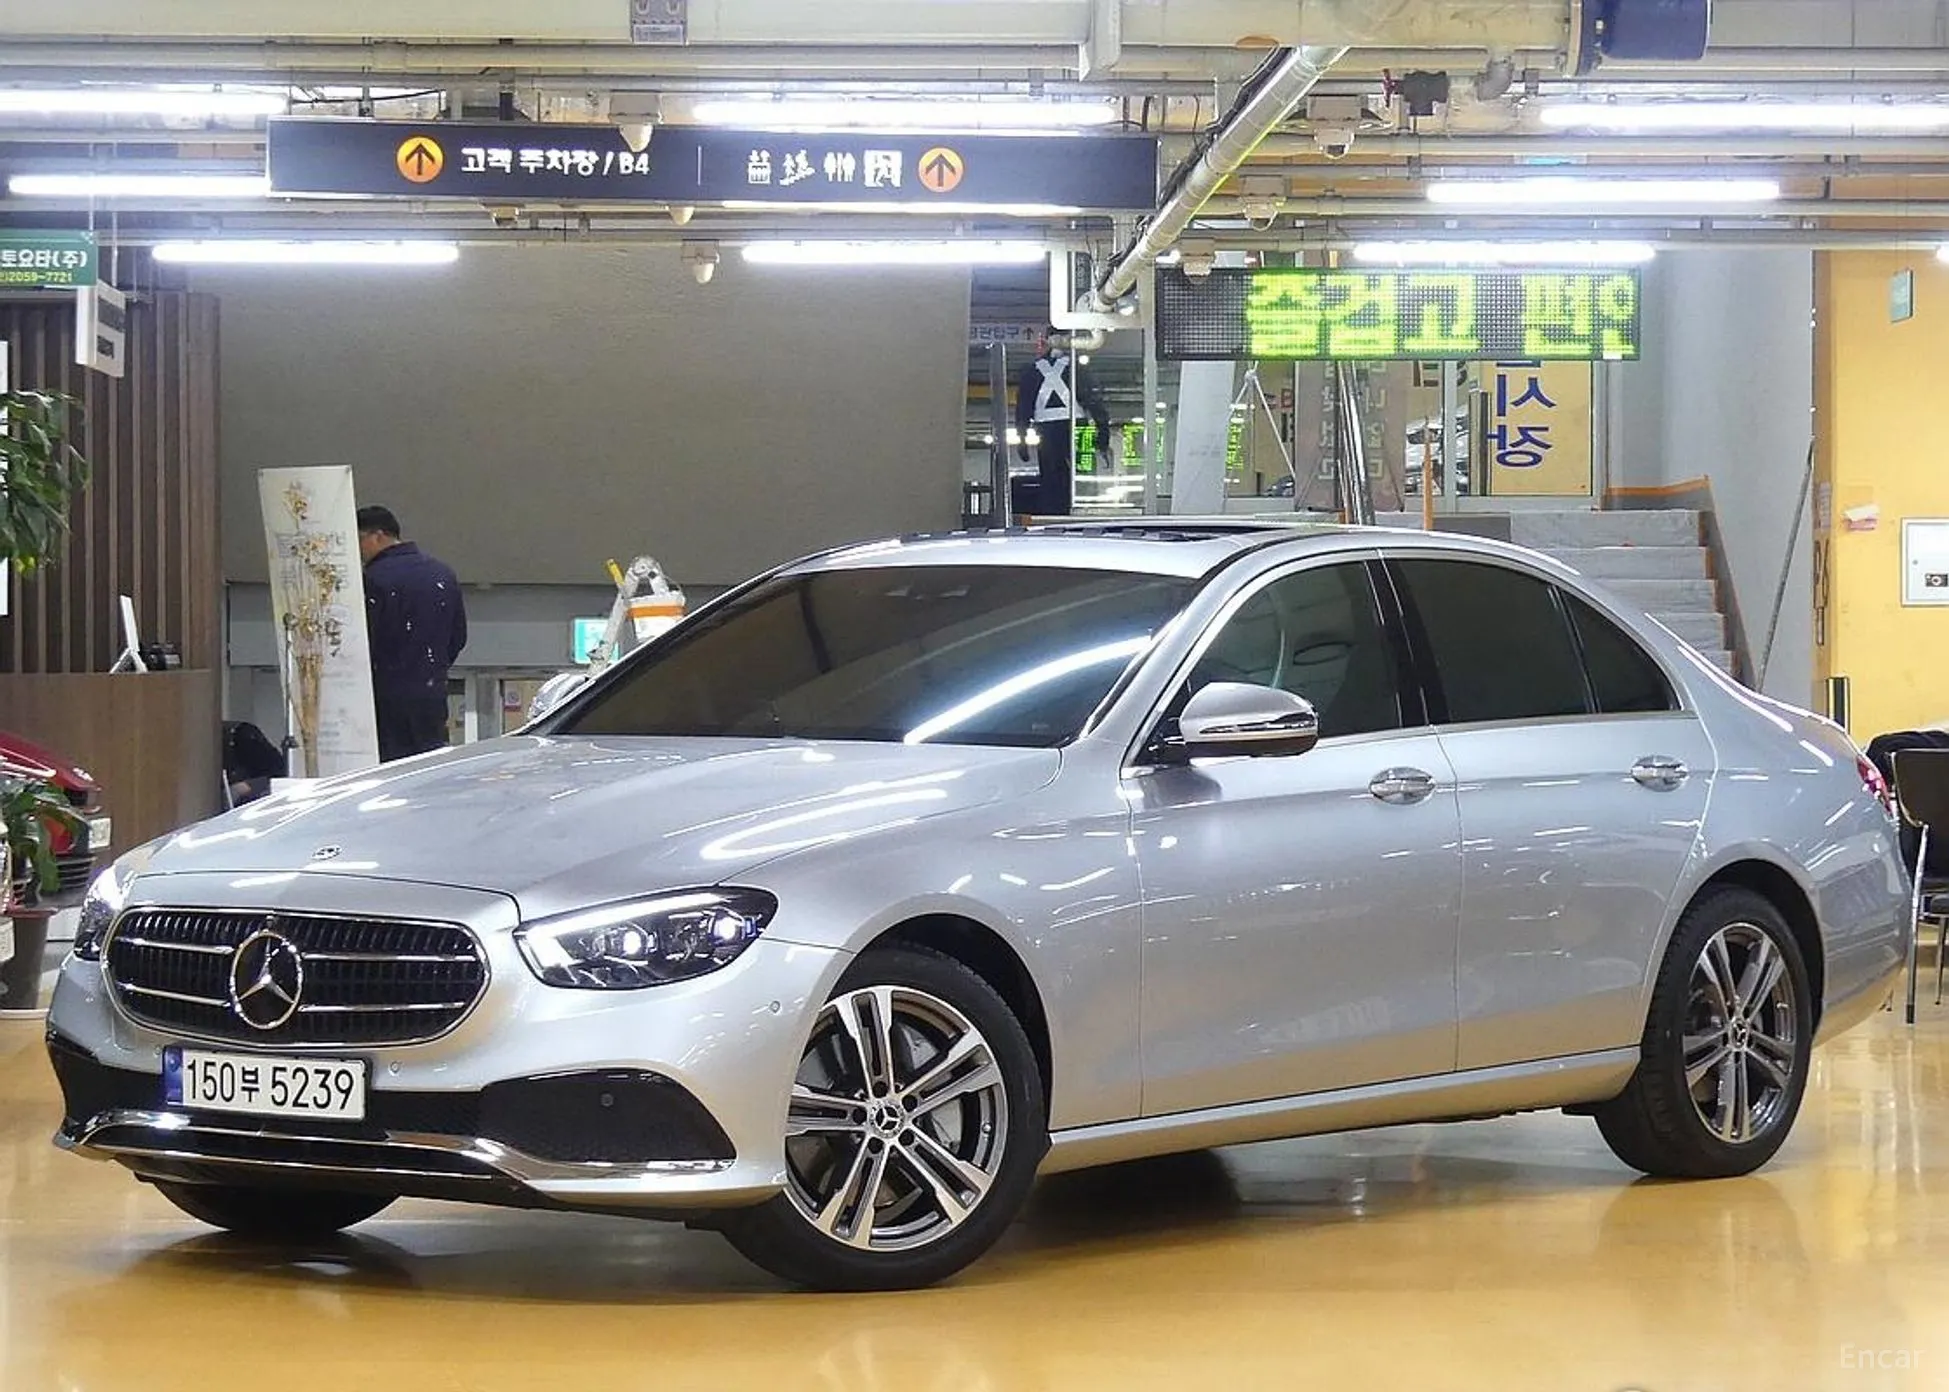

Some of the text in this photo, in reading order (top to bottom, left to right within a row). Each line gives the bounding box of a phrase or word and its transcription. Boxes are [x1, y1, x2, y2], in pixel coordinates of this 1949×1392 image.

[461, 147, 513, 174] 고객
[187, 1059, 355, 1111] 150부 5239
